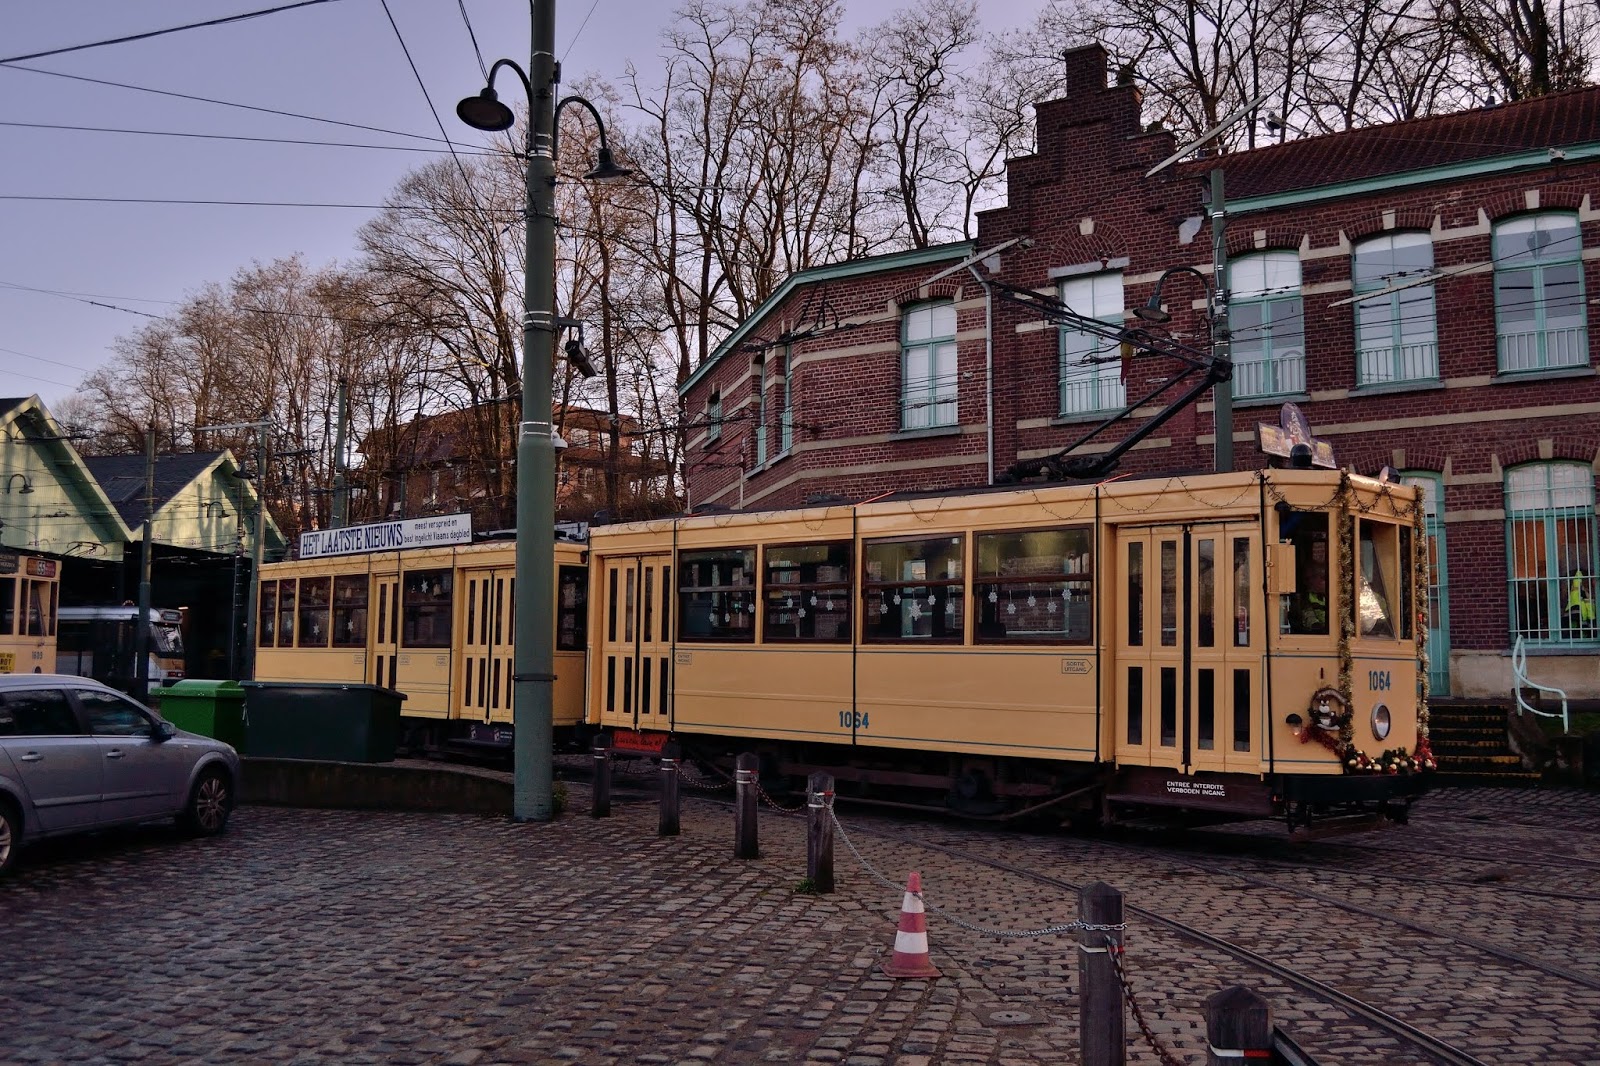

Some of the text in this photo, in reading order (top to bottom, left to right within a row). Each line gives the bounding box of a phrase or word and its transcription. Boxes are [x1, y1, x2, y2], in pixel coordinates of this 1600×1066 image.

[414, 522, 427, 530] meest
[428, 519, 450, 531] verspreid
[302, 523, 403, 555] HET LAATSTE NIEUWS
[404, 528, 471, 545] best ingelicht Vlaams dagblad
[1368, 671, 1391, 691] 1064
[839, 710, 869, 729] 1064
[1193, 782, 1224, 790] INTERDITE
